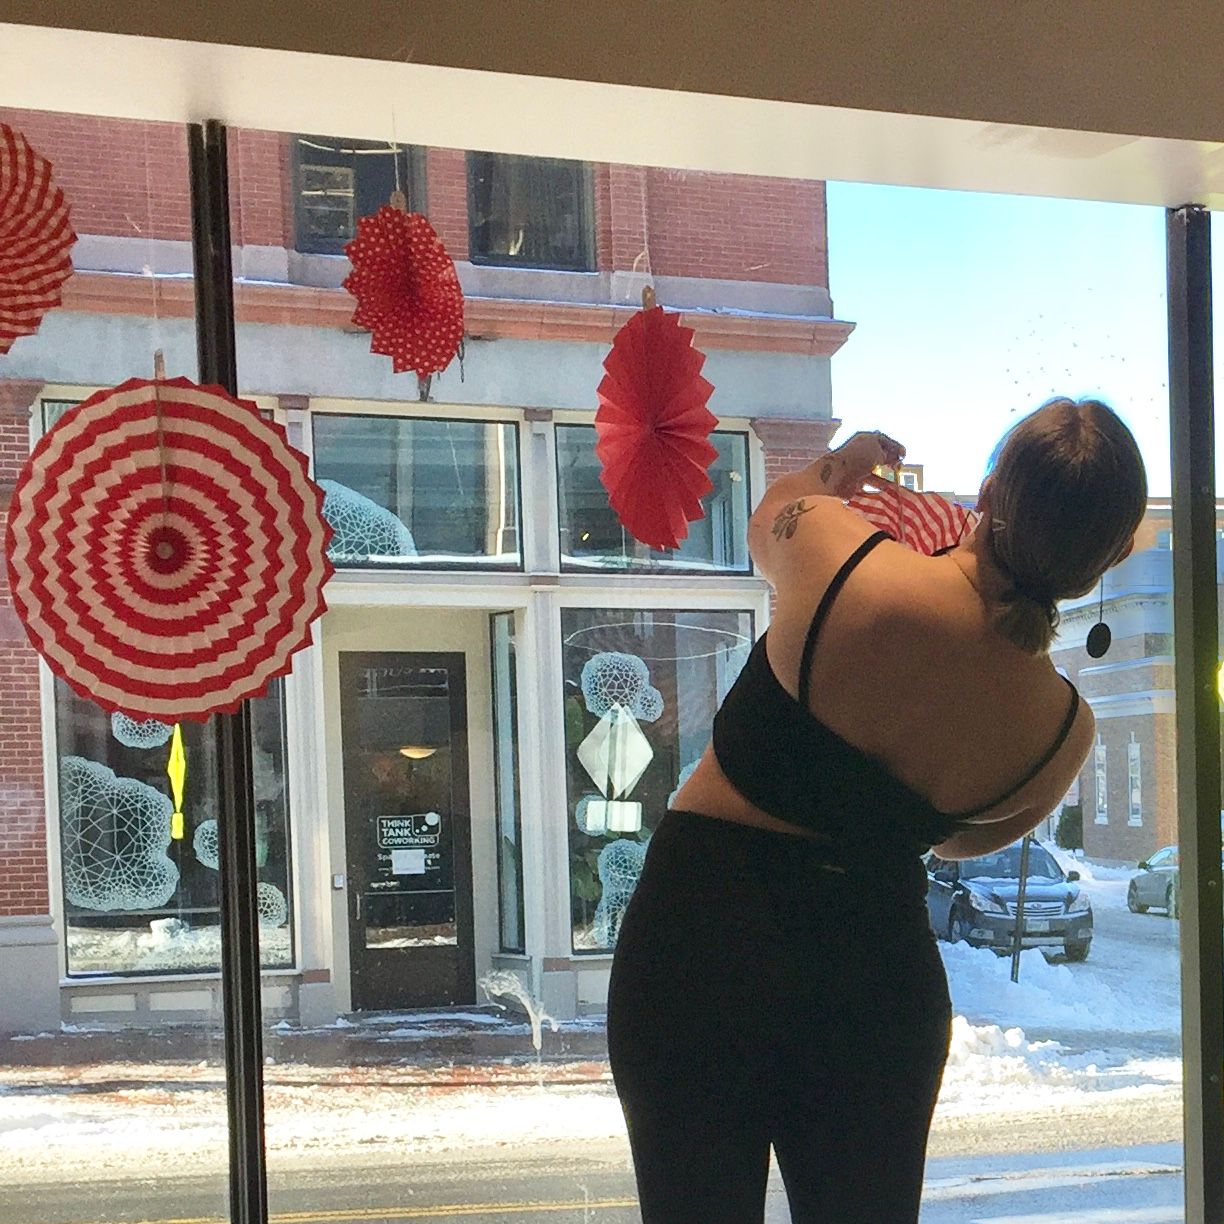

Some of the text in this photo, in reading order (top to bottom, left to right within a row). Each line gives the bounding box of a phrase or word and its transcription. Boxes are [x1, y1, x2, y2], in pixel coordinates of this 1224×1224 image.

[381, 819, 411, 828] THINK
[381, 828, 412, 837] TANK
[382, 837, 436, 845] COWORKING
